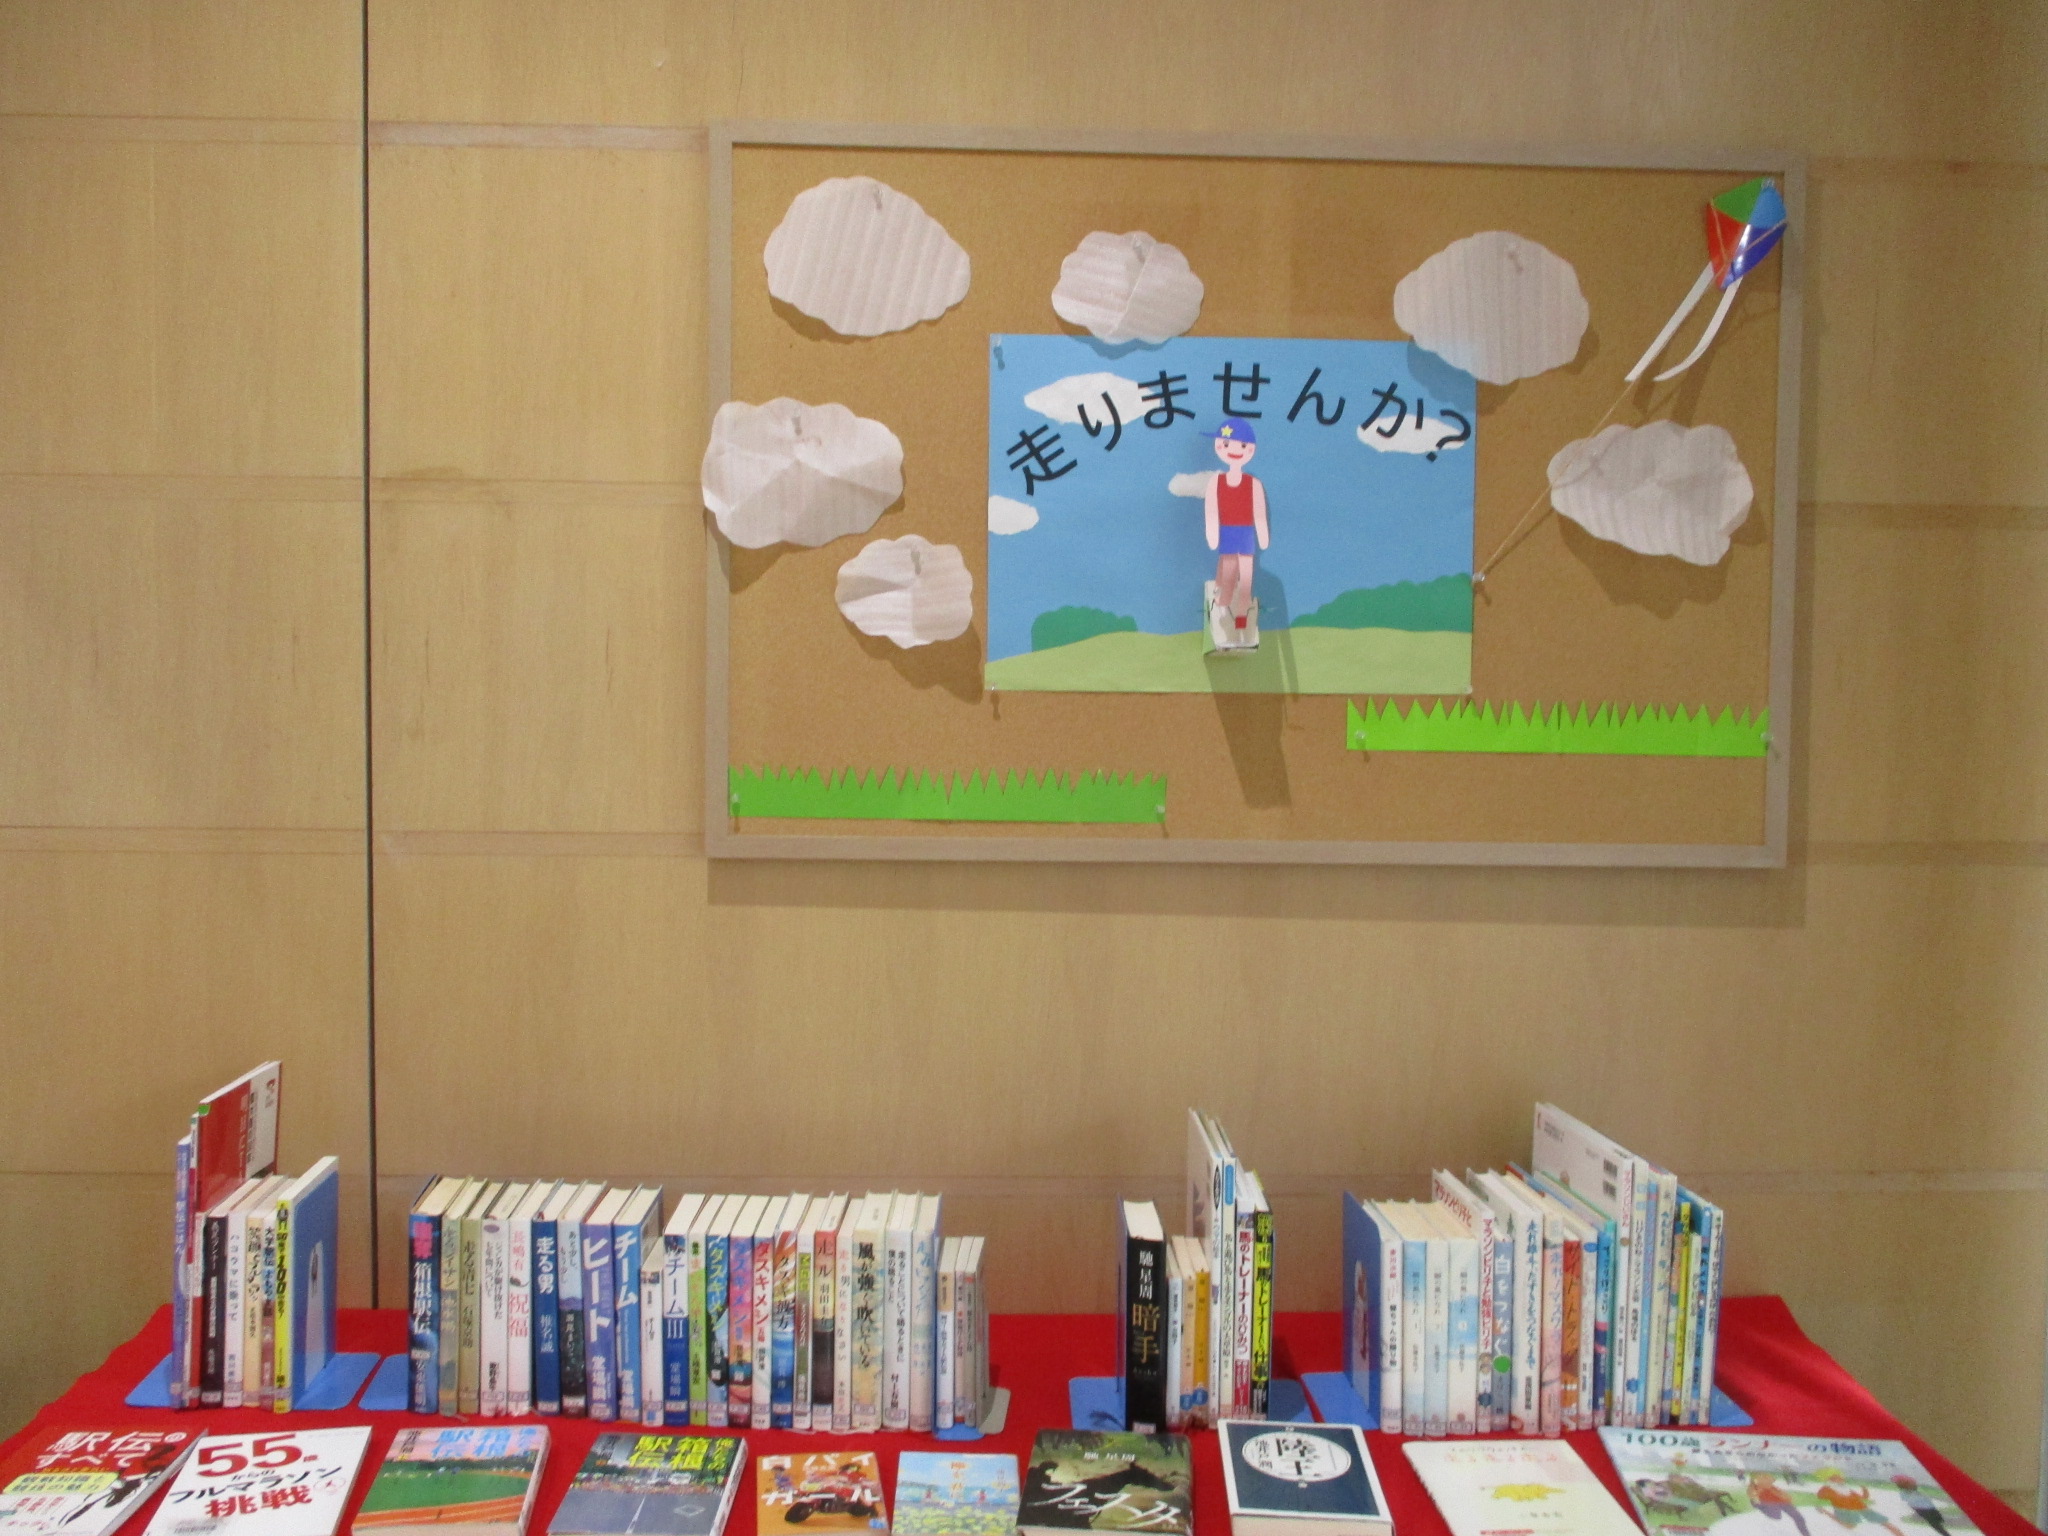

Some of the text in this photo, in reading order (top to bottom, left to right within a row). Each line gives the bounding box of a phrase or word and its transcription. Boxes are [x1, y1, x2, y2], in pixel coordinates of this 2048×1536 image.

[1006, 361, 1472, 497] 走りませんか?
[535, 1236, 555, 1295] 走る男
[583, 1237, 611, 1342] ヒート
[615, 1230, 639, 1312] チーム
[1138, 1250, 1153, 1300] 馳星周
[1238, 1231, 1252, 1354] 馬のトレーナーのひみつ
[509, 1293, 529, 1338] 祝福
[856, 1241, 875, 1369] 風が強く吹いている
[1131, 1303, 1161, 1363] 暗手
[36, 1452, 147, 1470] すべて
[169, 1466, 342, 1505] フルマラソン
[204, 1484, 313, 1518] 挑戦
[761, 1485, 881, 1506] ガール
